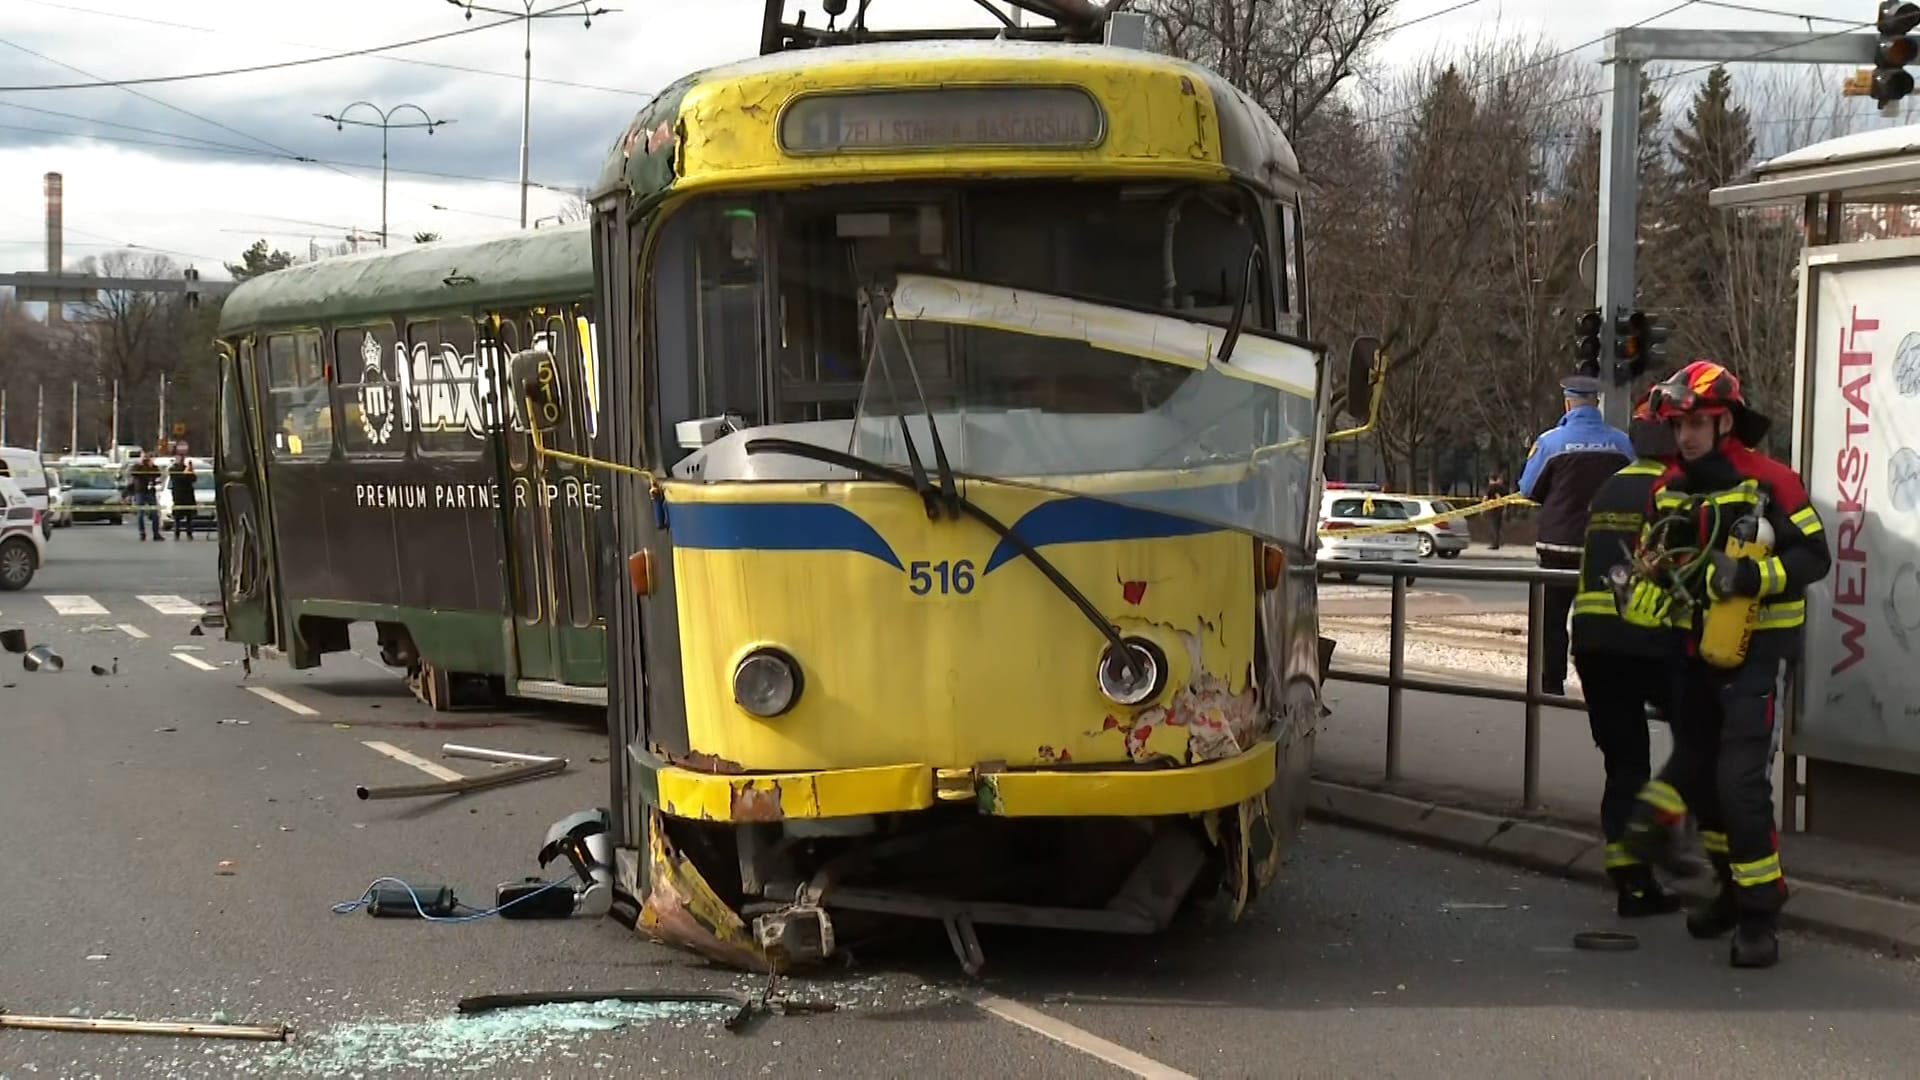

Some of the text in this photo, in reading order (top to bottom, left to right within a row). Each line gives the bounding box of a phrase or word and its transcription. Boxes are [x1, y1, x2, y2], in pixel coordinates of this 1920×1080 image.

[356, 484, 427, 509] PREMIUM
[1831, 305, 1879, 677] WERKSTATT
[909, 559, 975, 596] 516
